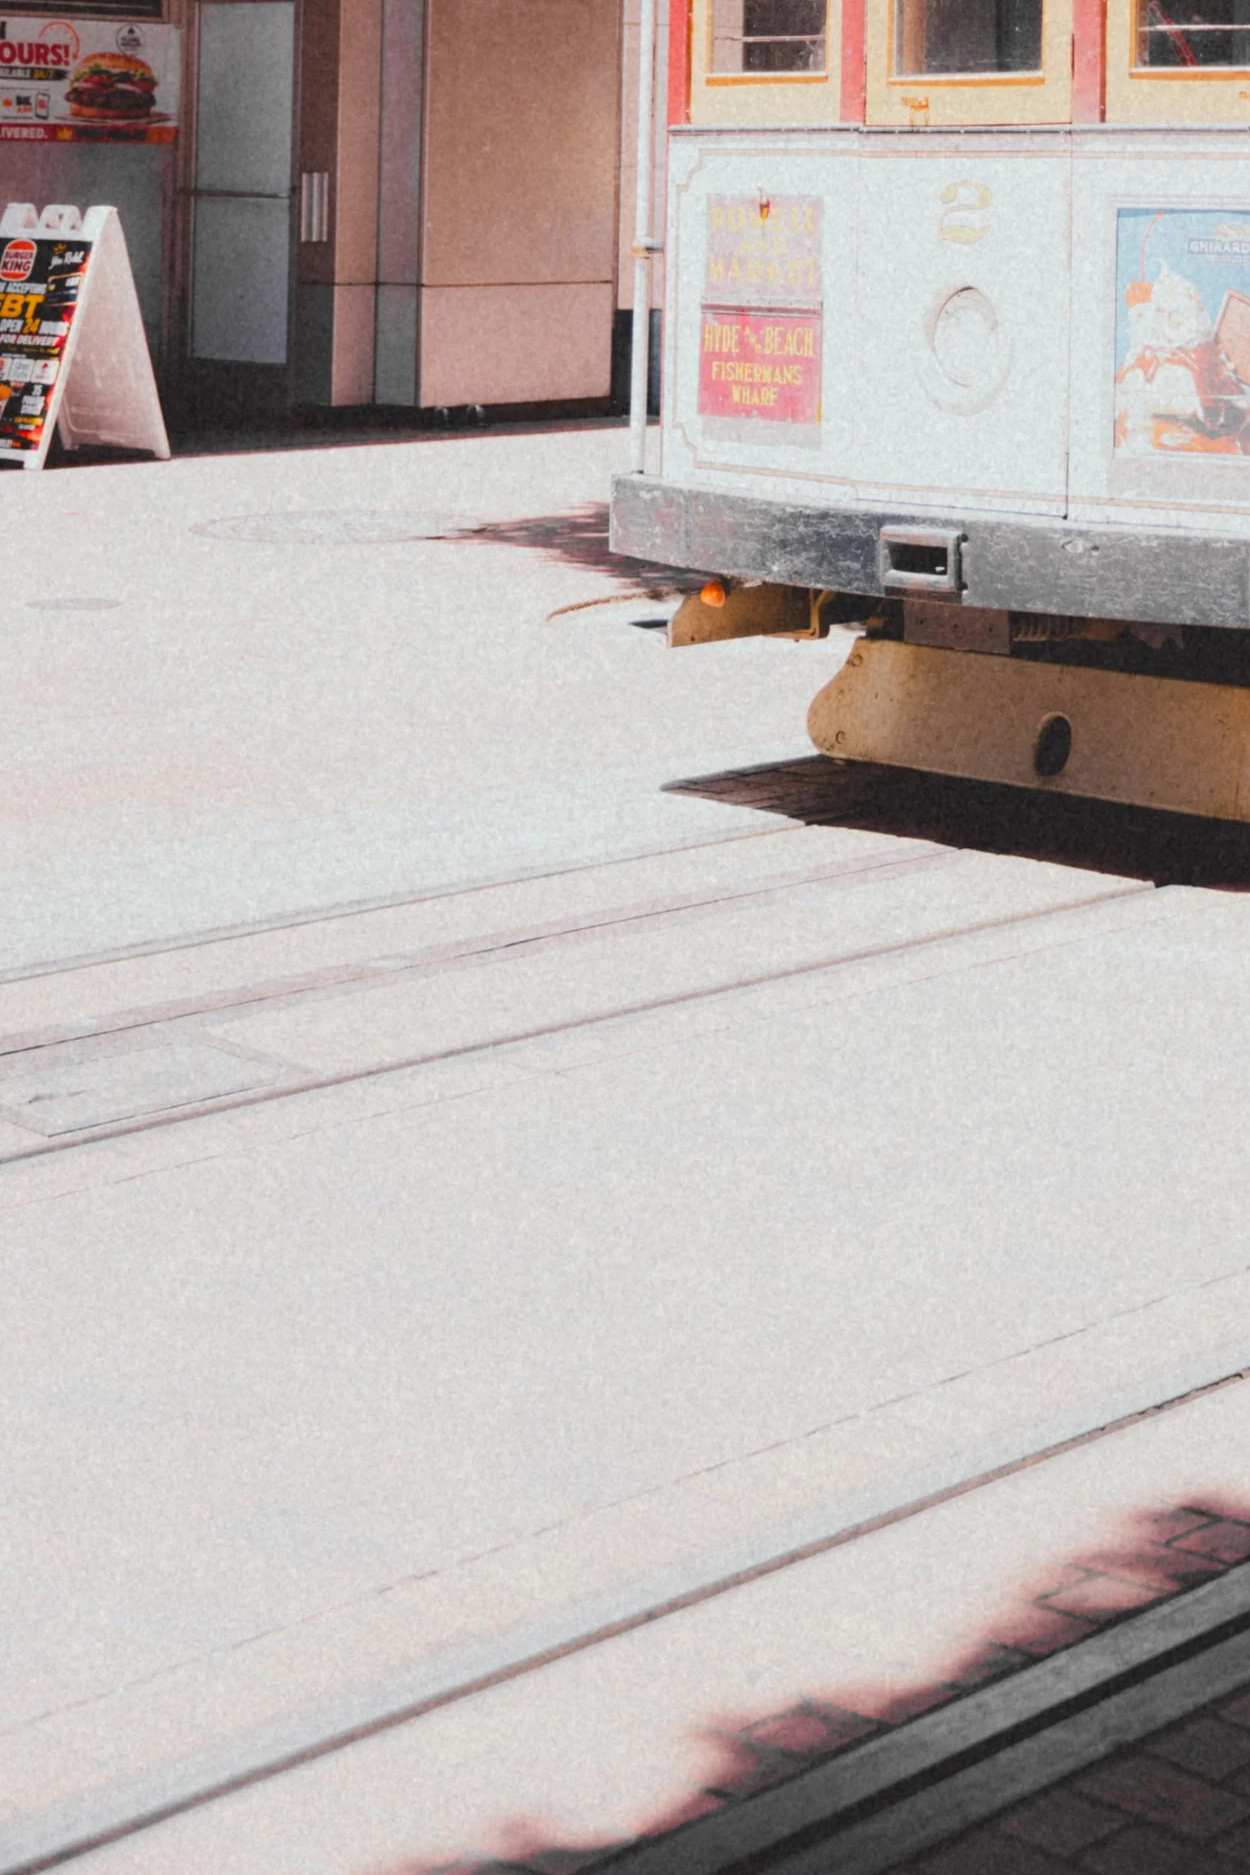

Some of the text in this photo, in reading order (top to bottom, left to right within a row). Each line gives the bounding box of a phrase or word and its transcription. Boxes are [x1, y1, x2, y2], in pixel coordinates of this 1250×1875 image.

[938, 180, 991, 244] 2
[1, 261, 31, 272] KING
[4, 252, 33, 260] BURGER
[704, 324, 740, 353] HYDE
[763, 326, 814, 357] BEACH
[712, 361, 801, 385] FISHERMANS
[731, 384, 777, 406] WHARF
